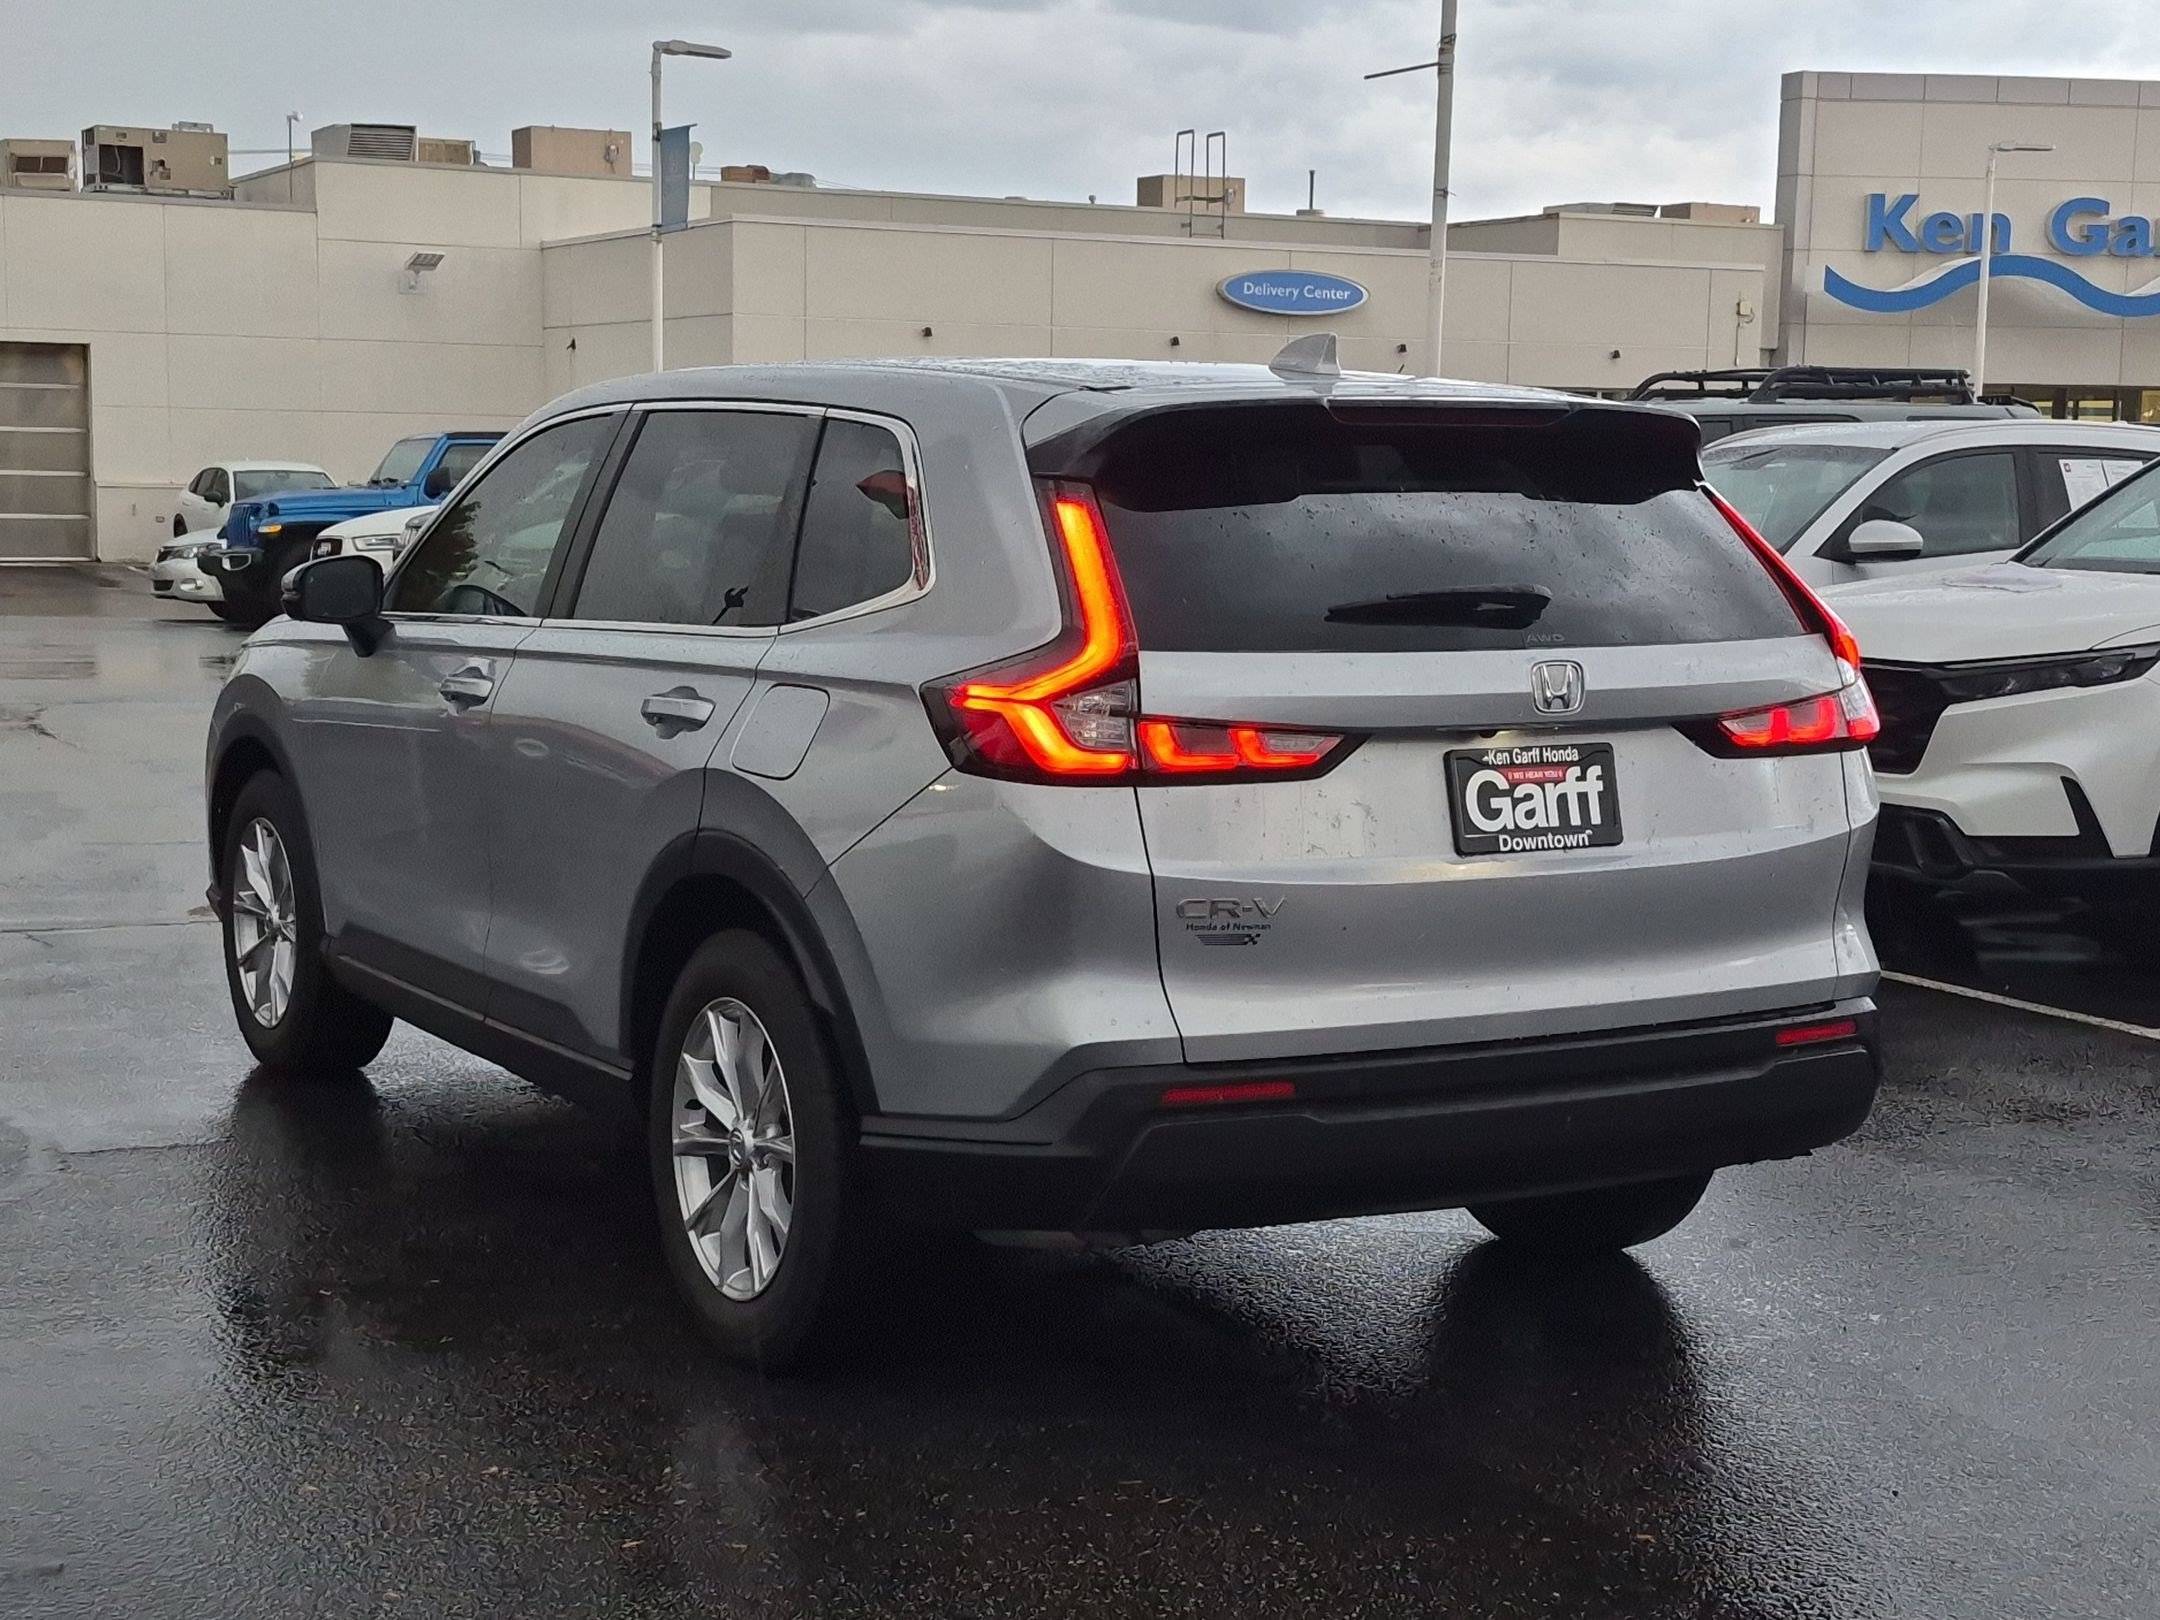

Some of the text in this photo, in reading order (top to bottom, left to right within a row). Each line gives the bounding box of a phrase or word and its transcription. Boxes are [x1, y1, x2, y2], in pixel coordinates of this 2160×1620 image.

[1864, 193, 2160, 257] Ken Ga
[1243, 282, 1350, 300] Delivery Center
[1527, 632, 1565, 642] AWD
[1488, 746, 1579, 765] Ken Garff Honda
[1465, 765, 1603, 832] Garff
[1499, 833, 1590, 852] Downtown
[1176, 896, 1286, 919] CR-V
[1186, 922, 1217, 931] Honda
[1221, 922, 1230, 931] of
